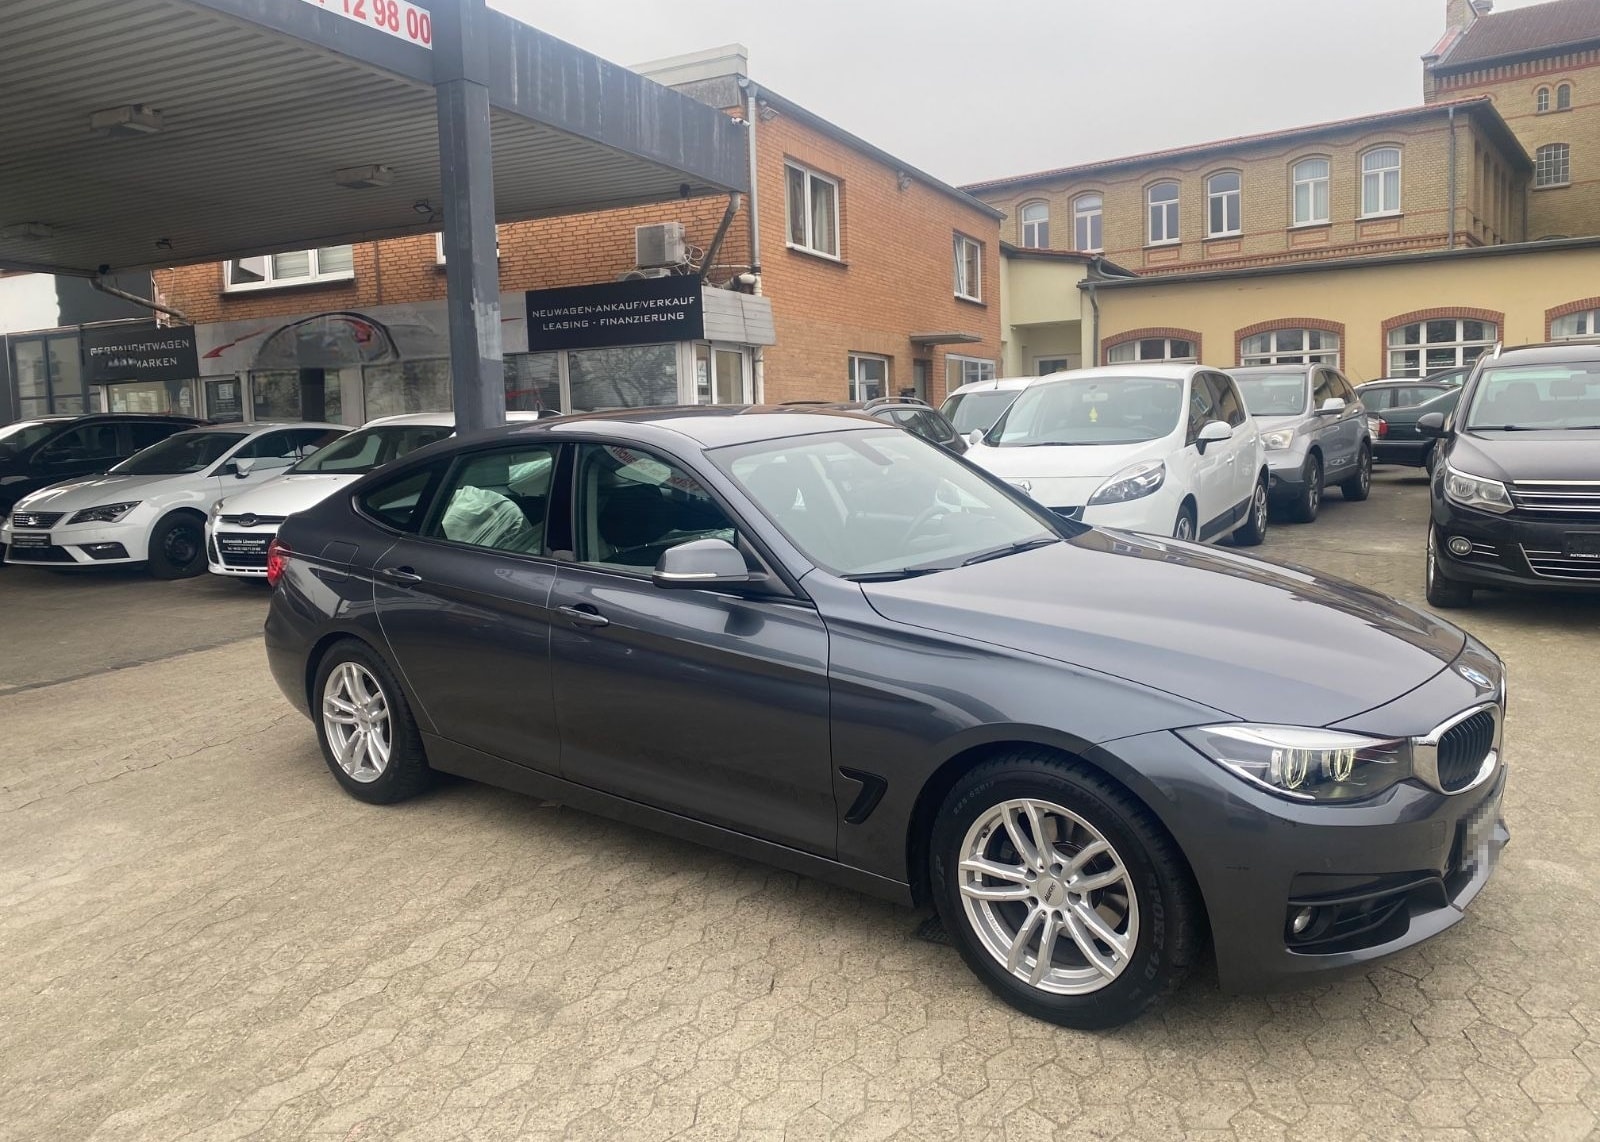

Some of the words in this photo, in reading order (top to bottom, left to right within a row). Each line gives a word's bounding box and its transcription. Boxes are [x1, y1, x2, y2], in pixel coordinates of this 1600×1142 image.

[373, 0, 400, 32] 98
[406, 8, 430, 44] 00
[542, 319, 589, 331] LEASING
[600, 311, 685, 326] FINANZIERUNG
